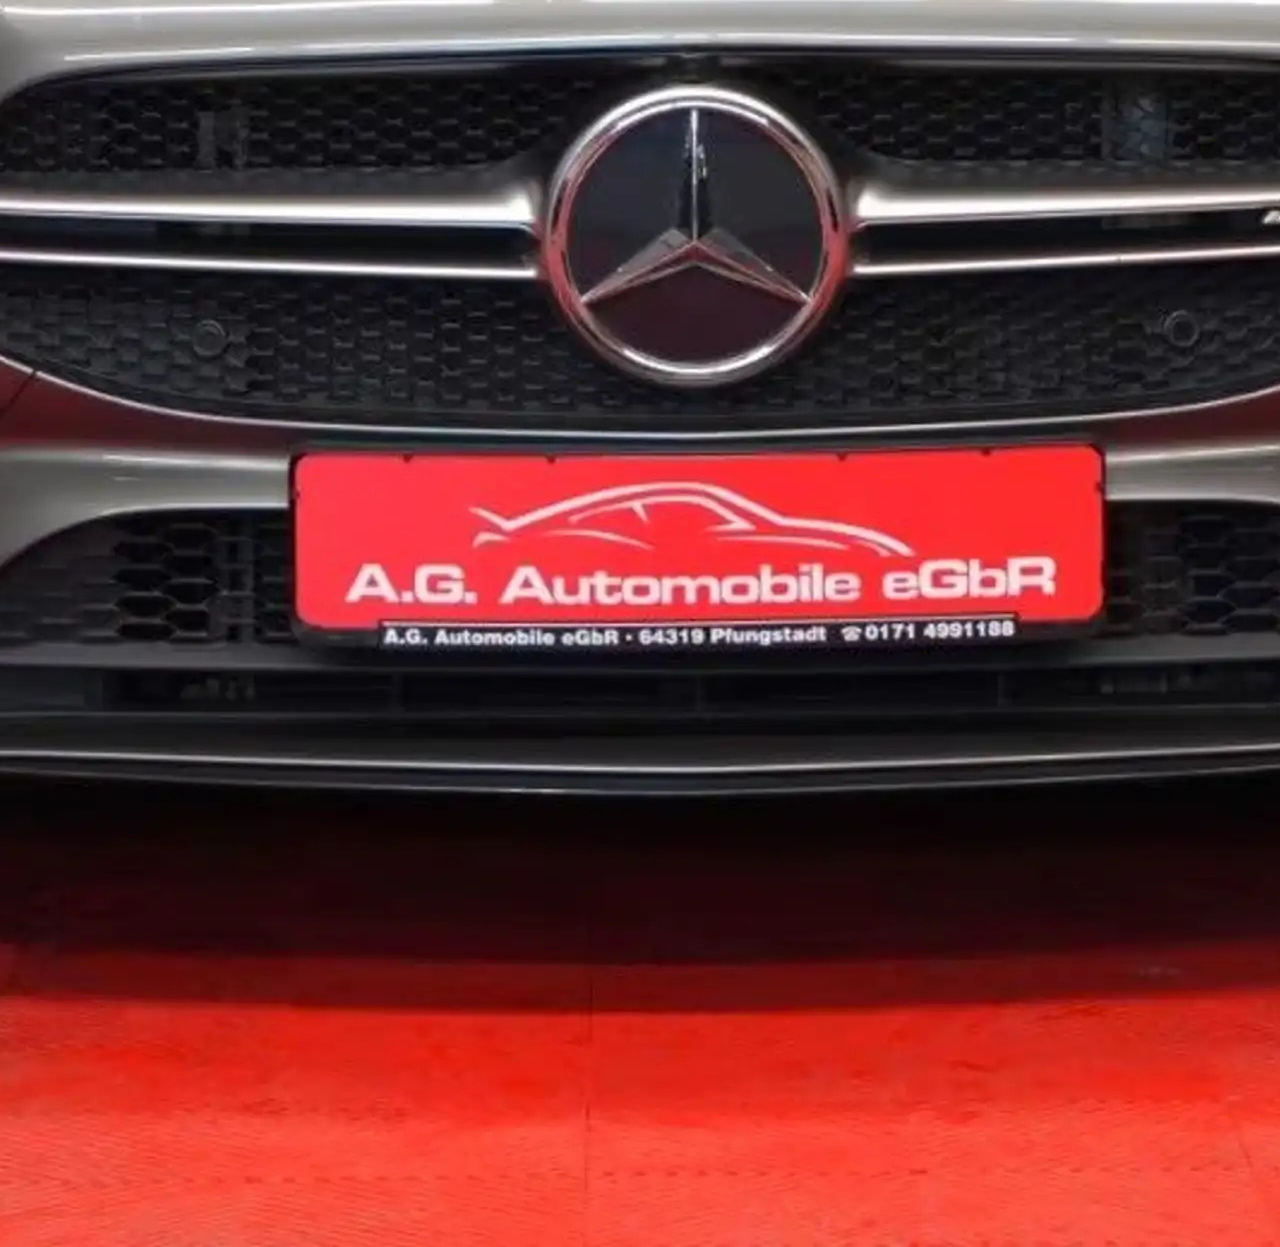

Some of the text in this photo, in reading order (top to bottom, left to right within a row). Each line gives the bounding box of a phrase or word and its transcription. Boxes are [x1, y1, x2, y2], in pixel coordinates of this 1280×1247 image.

[345, 556, 1057, 604] A.G. Automobile eGbR
[383, 620, 1015, 646] A.G. Automobile eGbR 64319 Pfungstadt 0171 4991188
